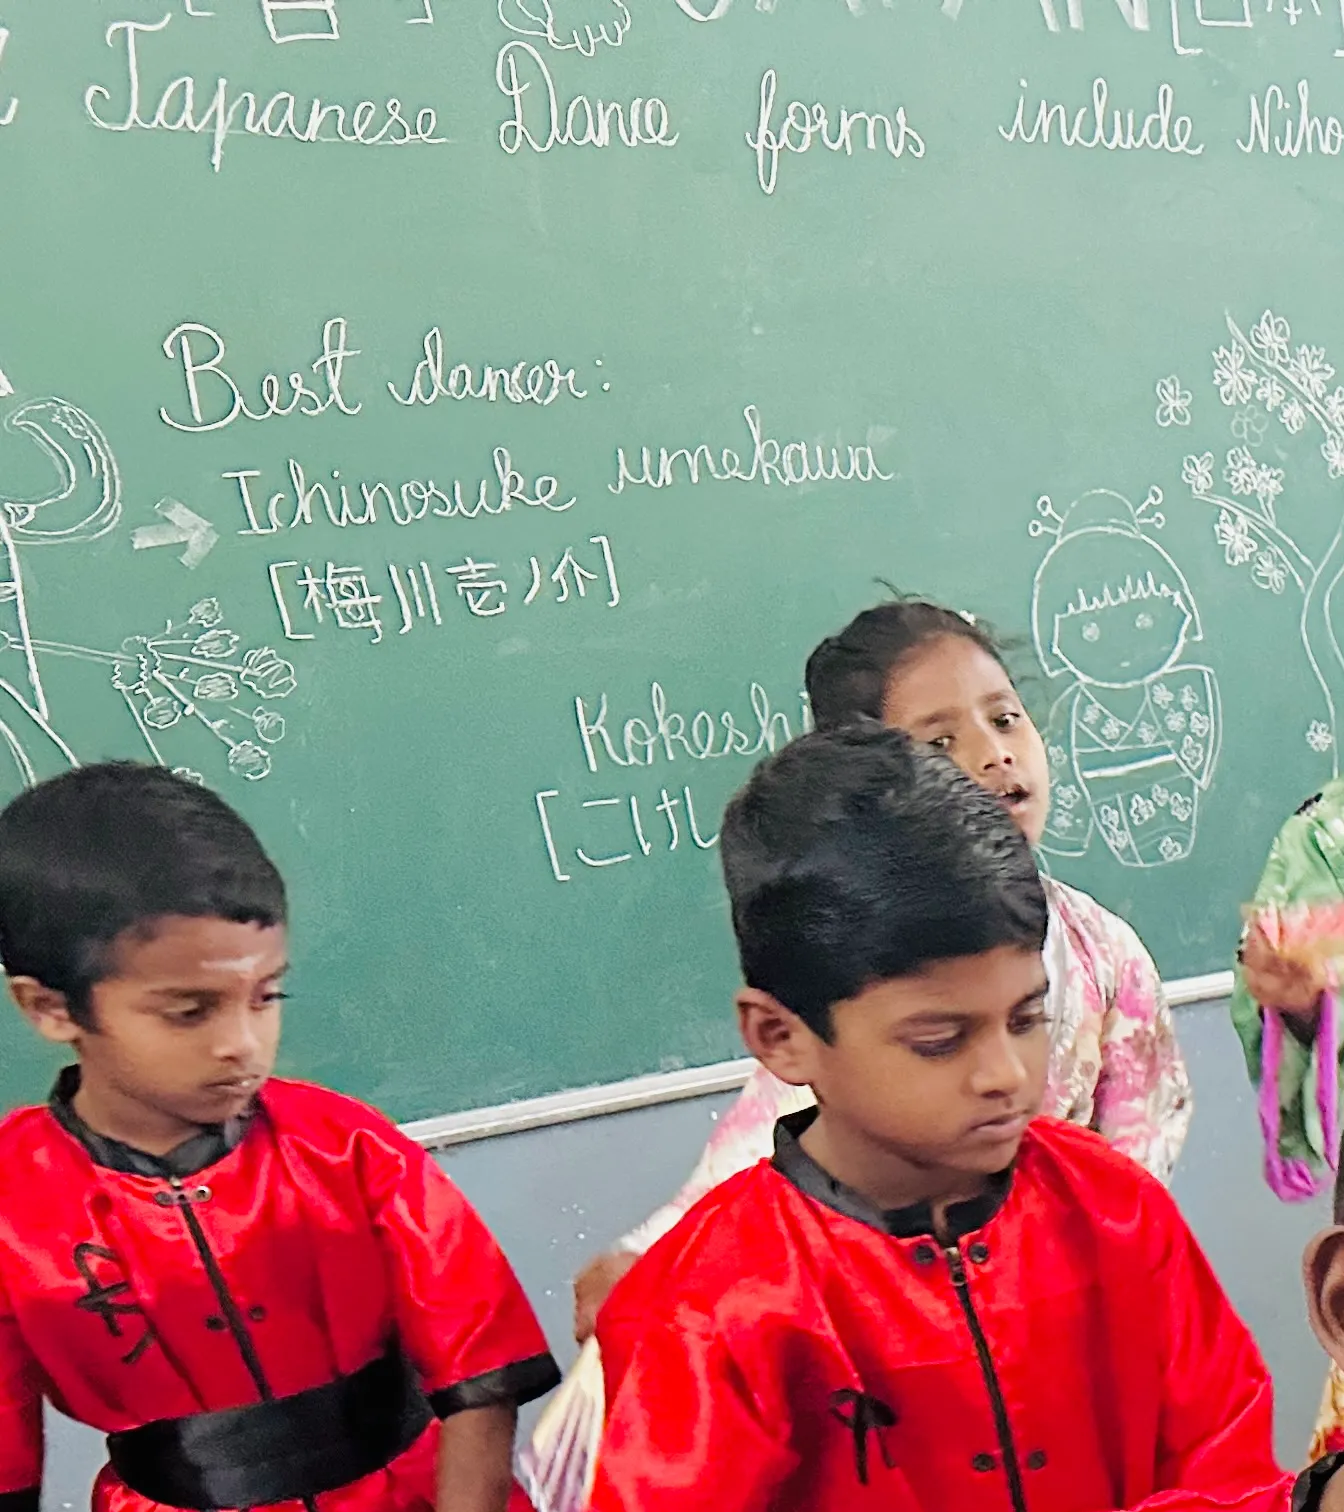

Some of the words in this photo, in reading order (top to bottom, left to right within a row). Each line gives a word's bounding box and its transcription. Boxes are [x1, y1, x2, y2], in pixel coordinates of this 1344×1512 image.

[85, 12, 448, 173] Japanese
[496, 40, 680, 154] Dance
[746, 69, 926, 195] forms
[998, 77, 1205, 156] include
[159, 315, 364, 433] Best
[221, 445, 578, 537] Ichinosuke
[575, 681, 812, 773] Kokeshi
